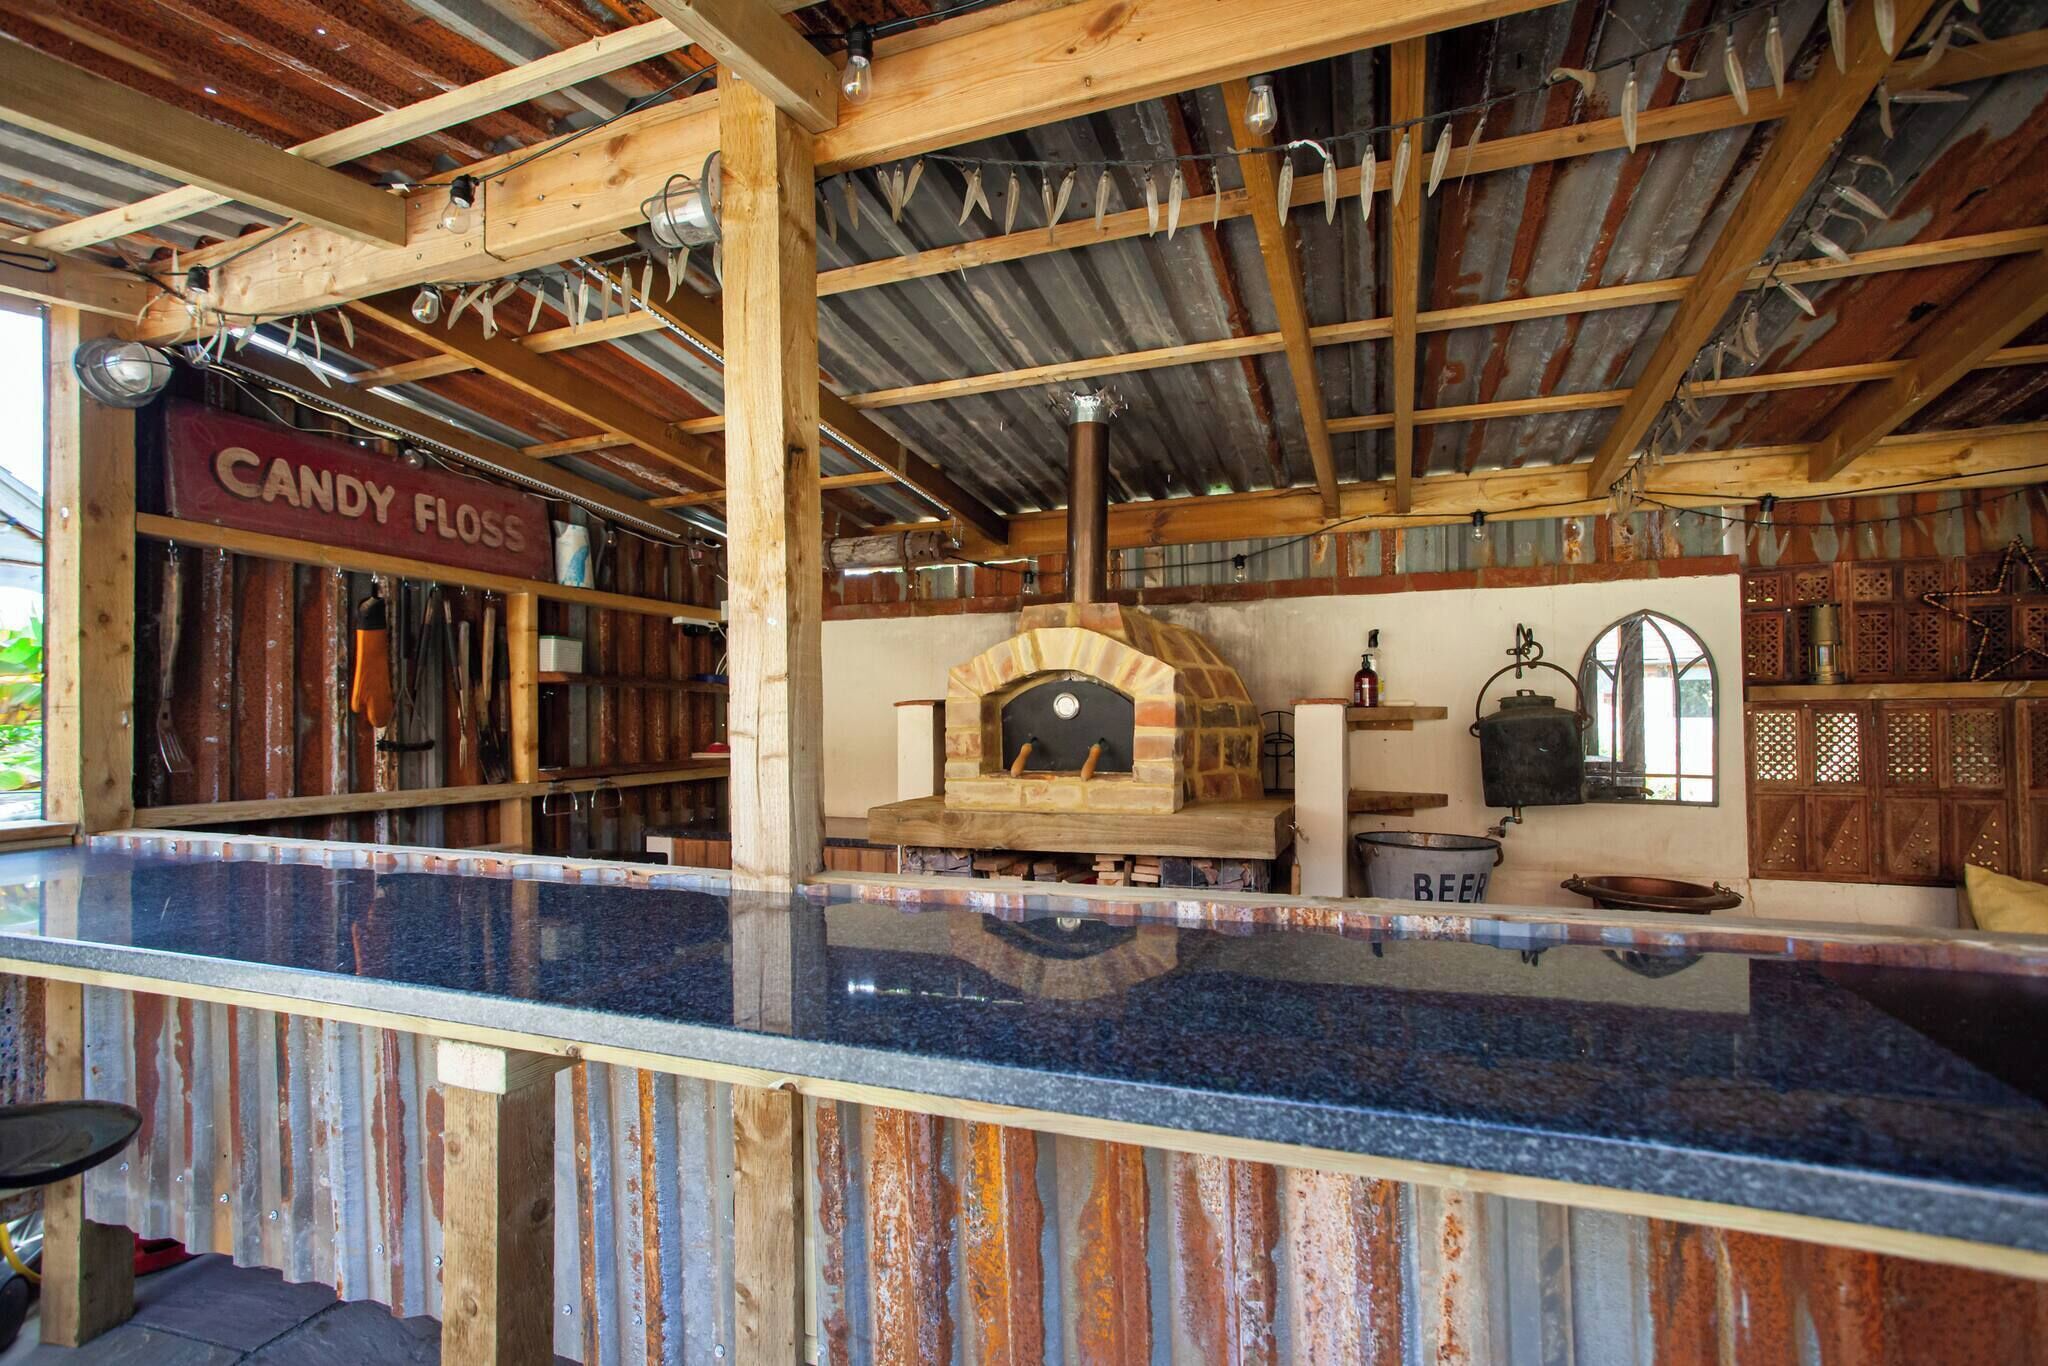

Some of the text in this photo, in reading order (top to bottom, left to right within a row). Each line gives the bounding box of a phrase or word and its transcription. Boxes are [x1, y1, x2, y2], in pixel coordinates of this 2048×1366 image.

[214, 446, 526, 552] CANDY FLOSS
[1413, 873, 1488, 903] BEER
